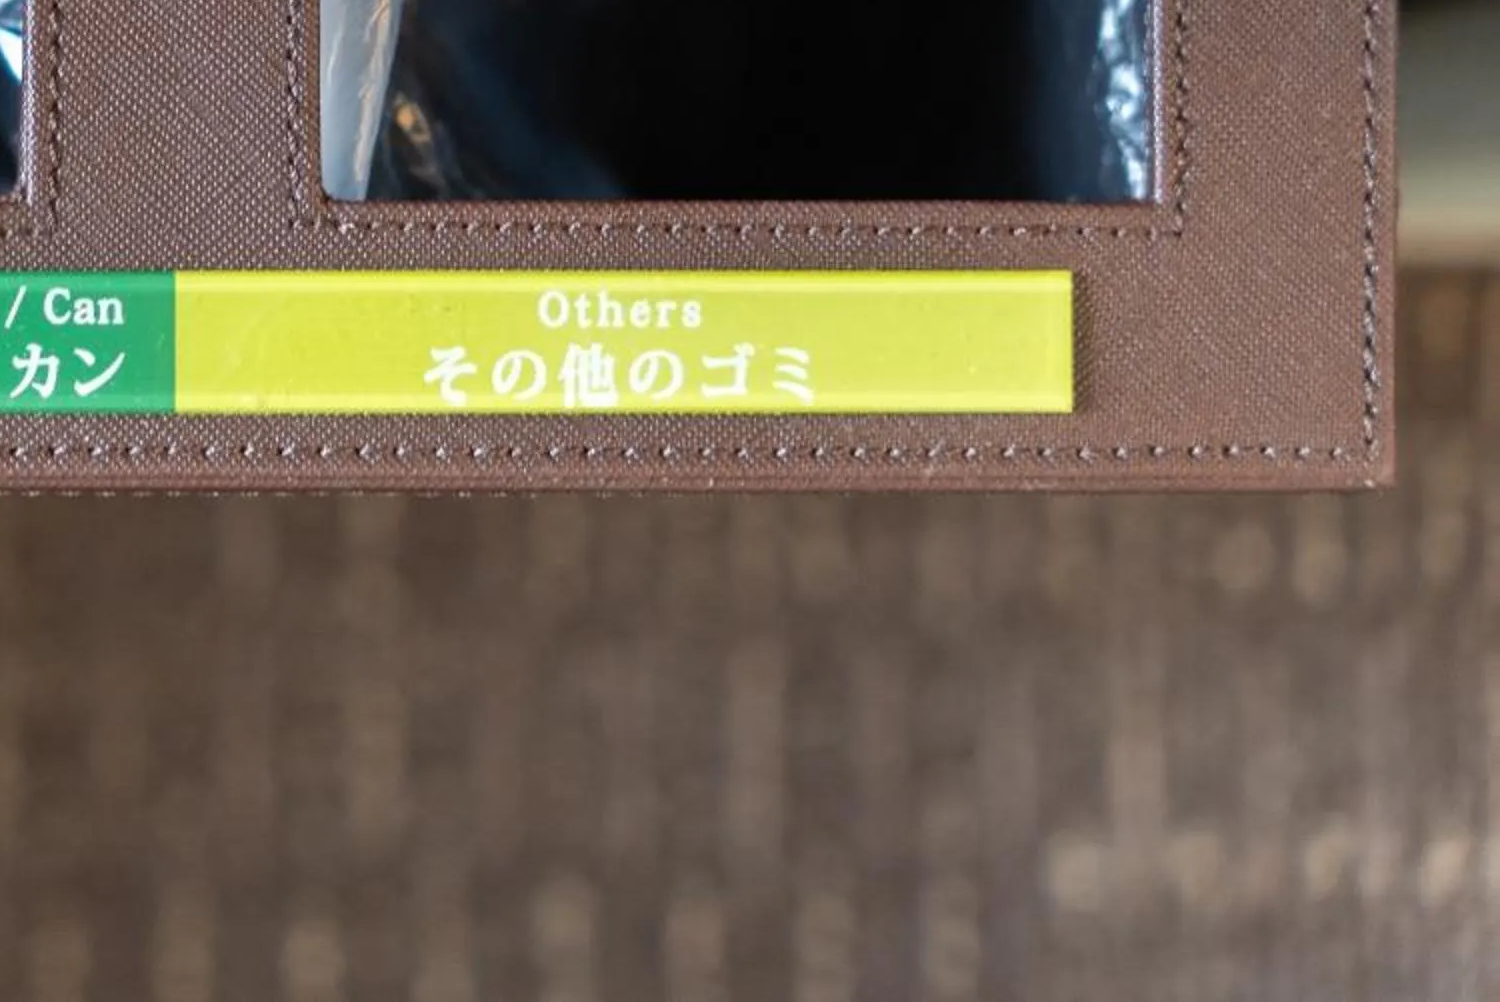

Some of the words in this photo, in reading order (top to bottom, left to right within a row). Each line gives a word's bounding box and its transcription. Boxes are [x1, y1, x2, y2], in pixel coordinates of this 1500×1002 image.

[4, 285, 27, 328] /
[43, 288, 125, 326] Can
[536, 289, 704, 329] Others
[423, 341, 816, 407] その他のゴミ
